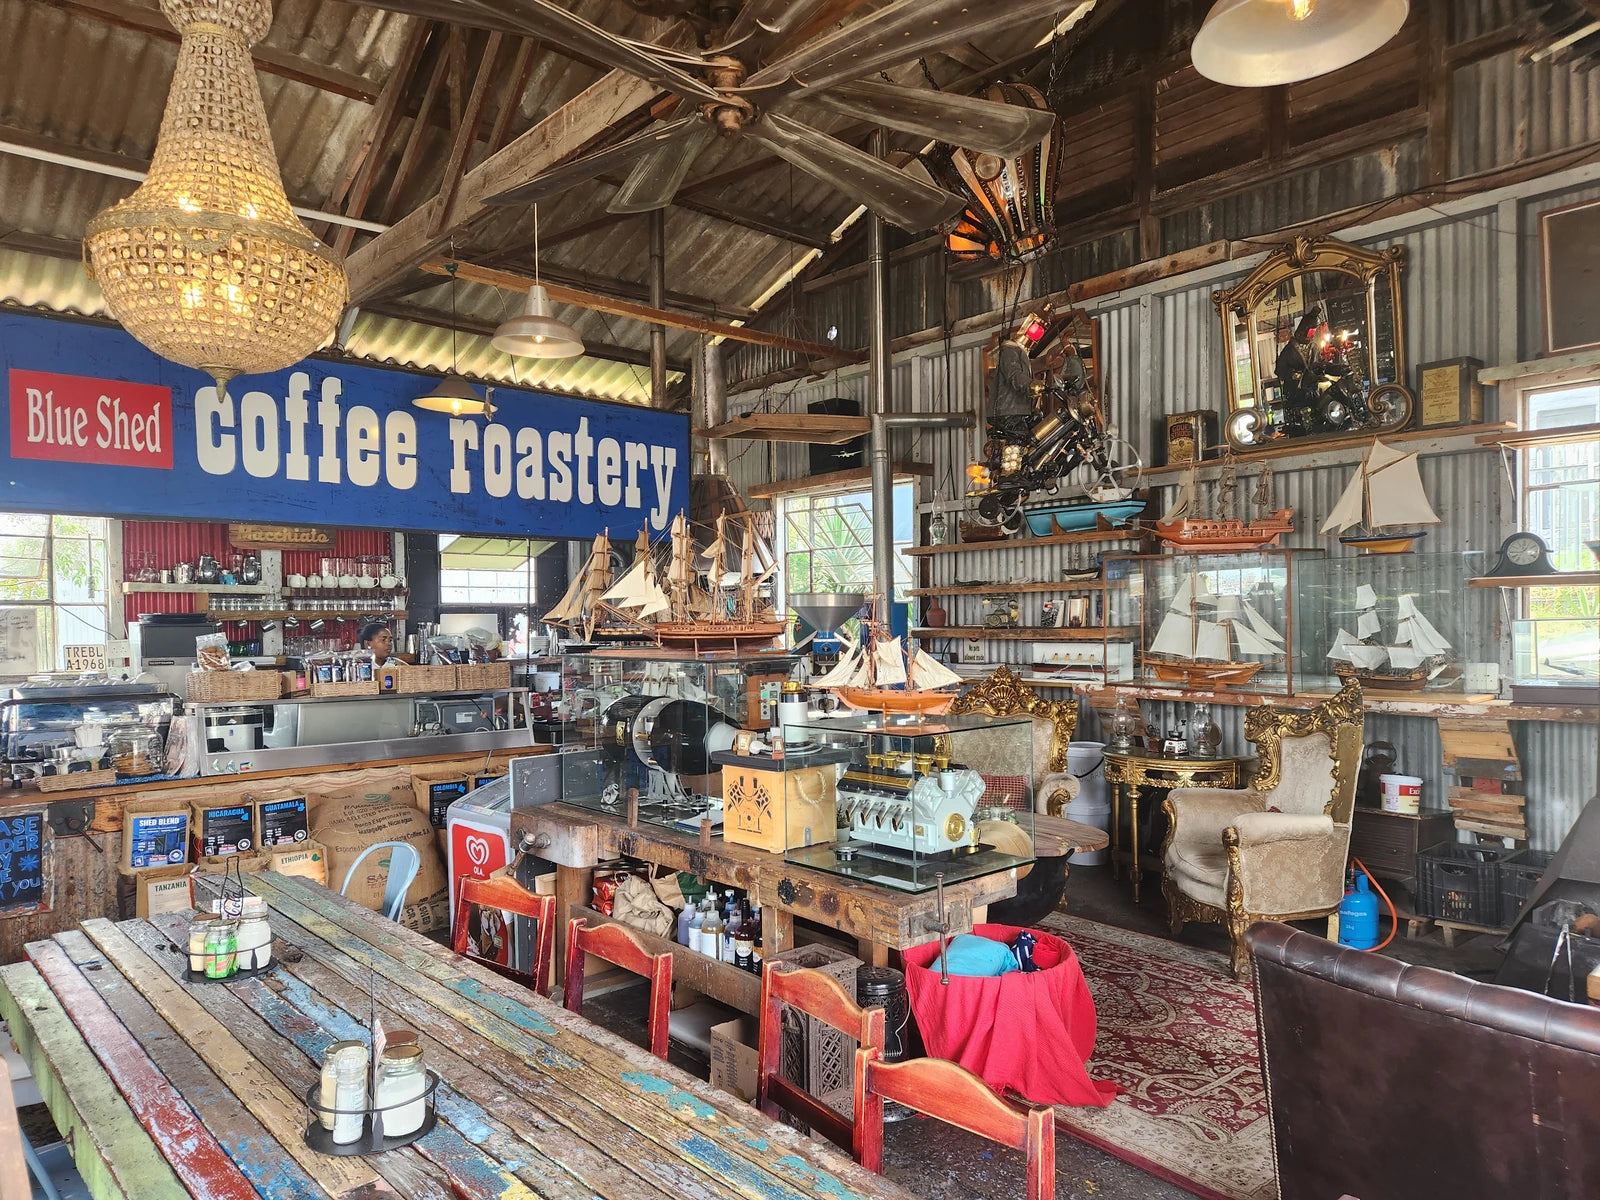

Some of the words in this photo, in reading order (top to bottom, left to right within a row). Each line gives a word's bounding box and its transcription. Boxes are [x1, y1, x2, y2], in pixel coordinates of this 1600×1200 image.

[26, 387, 89, 447] Blue
[96, 395, 161, 453] Shed
[195, 372, 417, 489] coffee
[450, 417, 677, 531] roastery
[238, 525, 329, 543] Macchiato
[65, 646, 103, 658] TREBL
[66, 659, 105, 671] A-1968
[433, 783, 458, 791] COLOMBIA
[208, 808, 245, 818] NICARAGUA
[139, 818, 157, 827] SHED
[158, 817, 180, 826] BLEND
[281, 853, 309, 865] ETHIOPIA
[155, 881, 187, 892] TANZANIA
